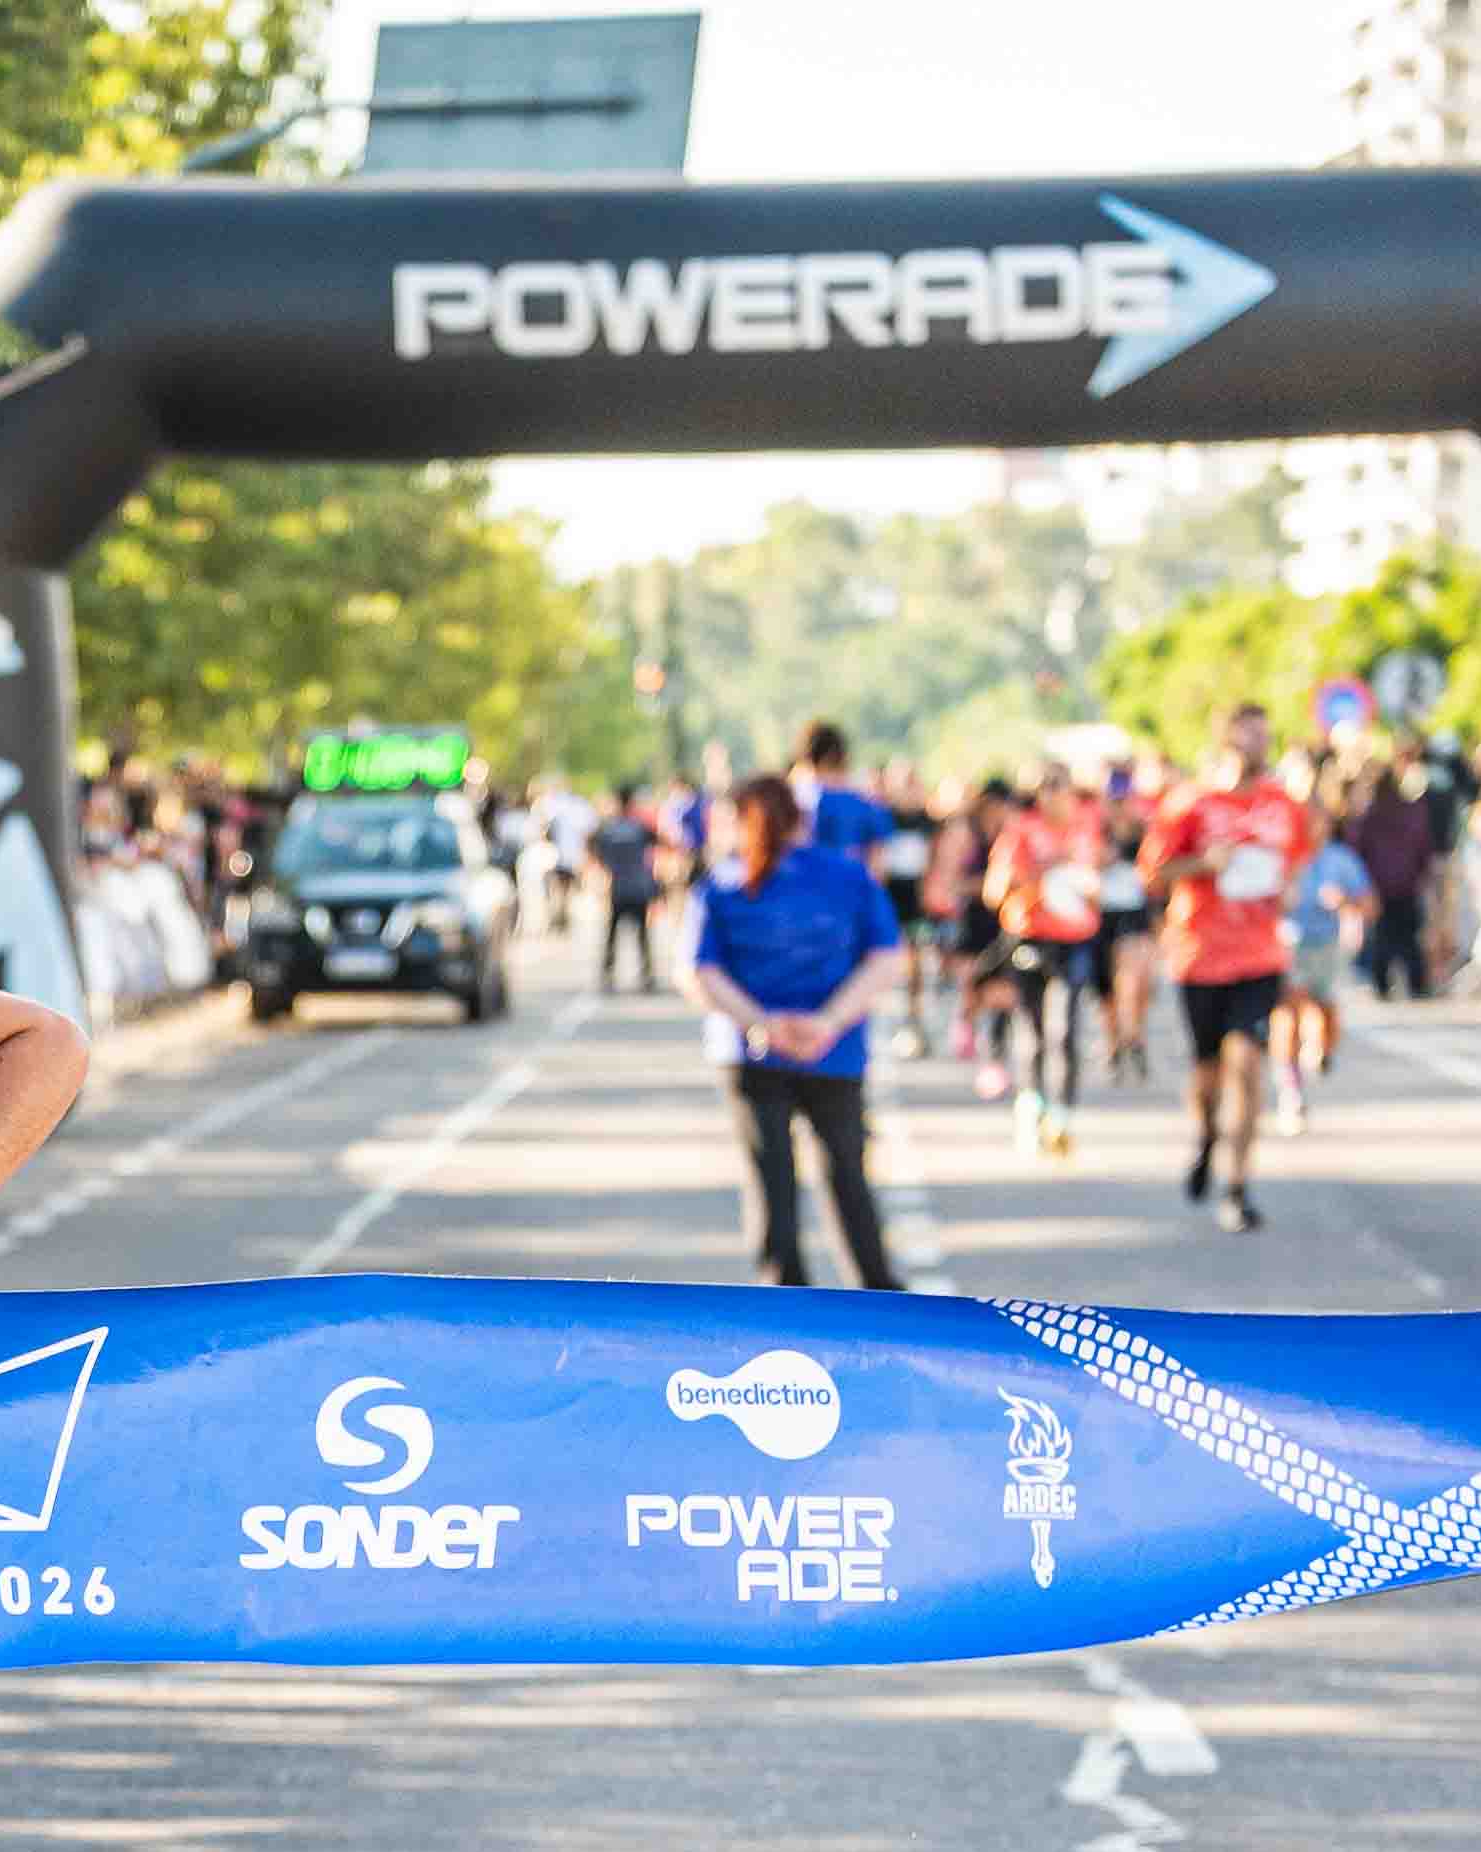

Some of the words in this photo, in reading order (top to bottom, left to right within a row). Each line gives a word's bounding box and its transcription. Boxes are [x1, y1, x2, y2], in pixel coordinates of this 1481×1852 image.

[393, 242, 1178, 361] POWERADE
[677, 1382, 832, 1407] benedictino
[625, 1494, 895, 1548] POWER
[1003, 1484, 1077, 1514] ARDEC
[239, 1504, 521, 1571] SONDER
